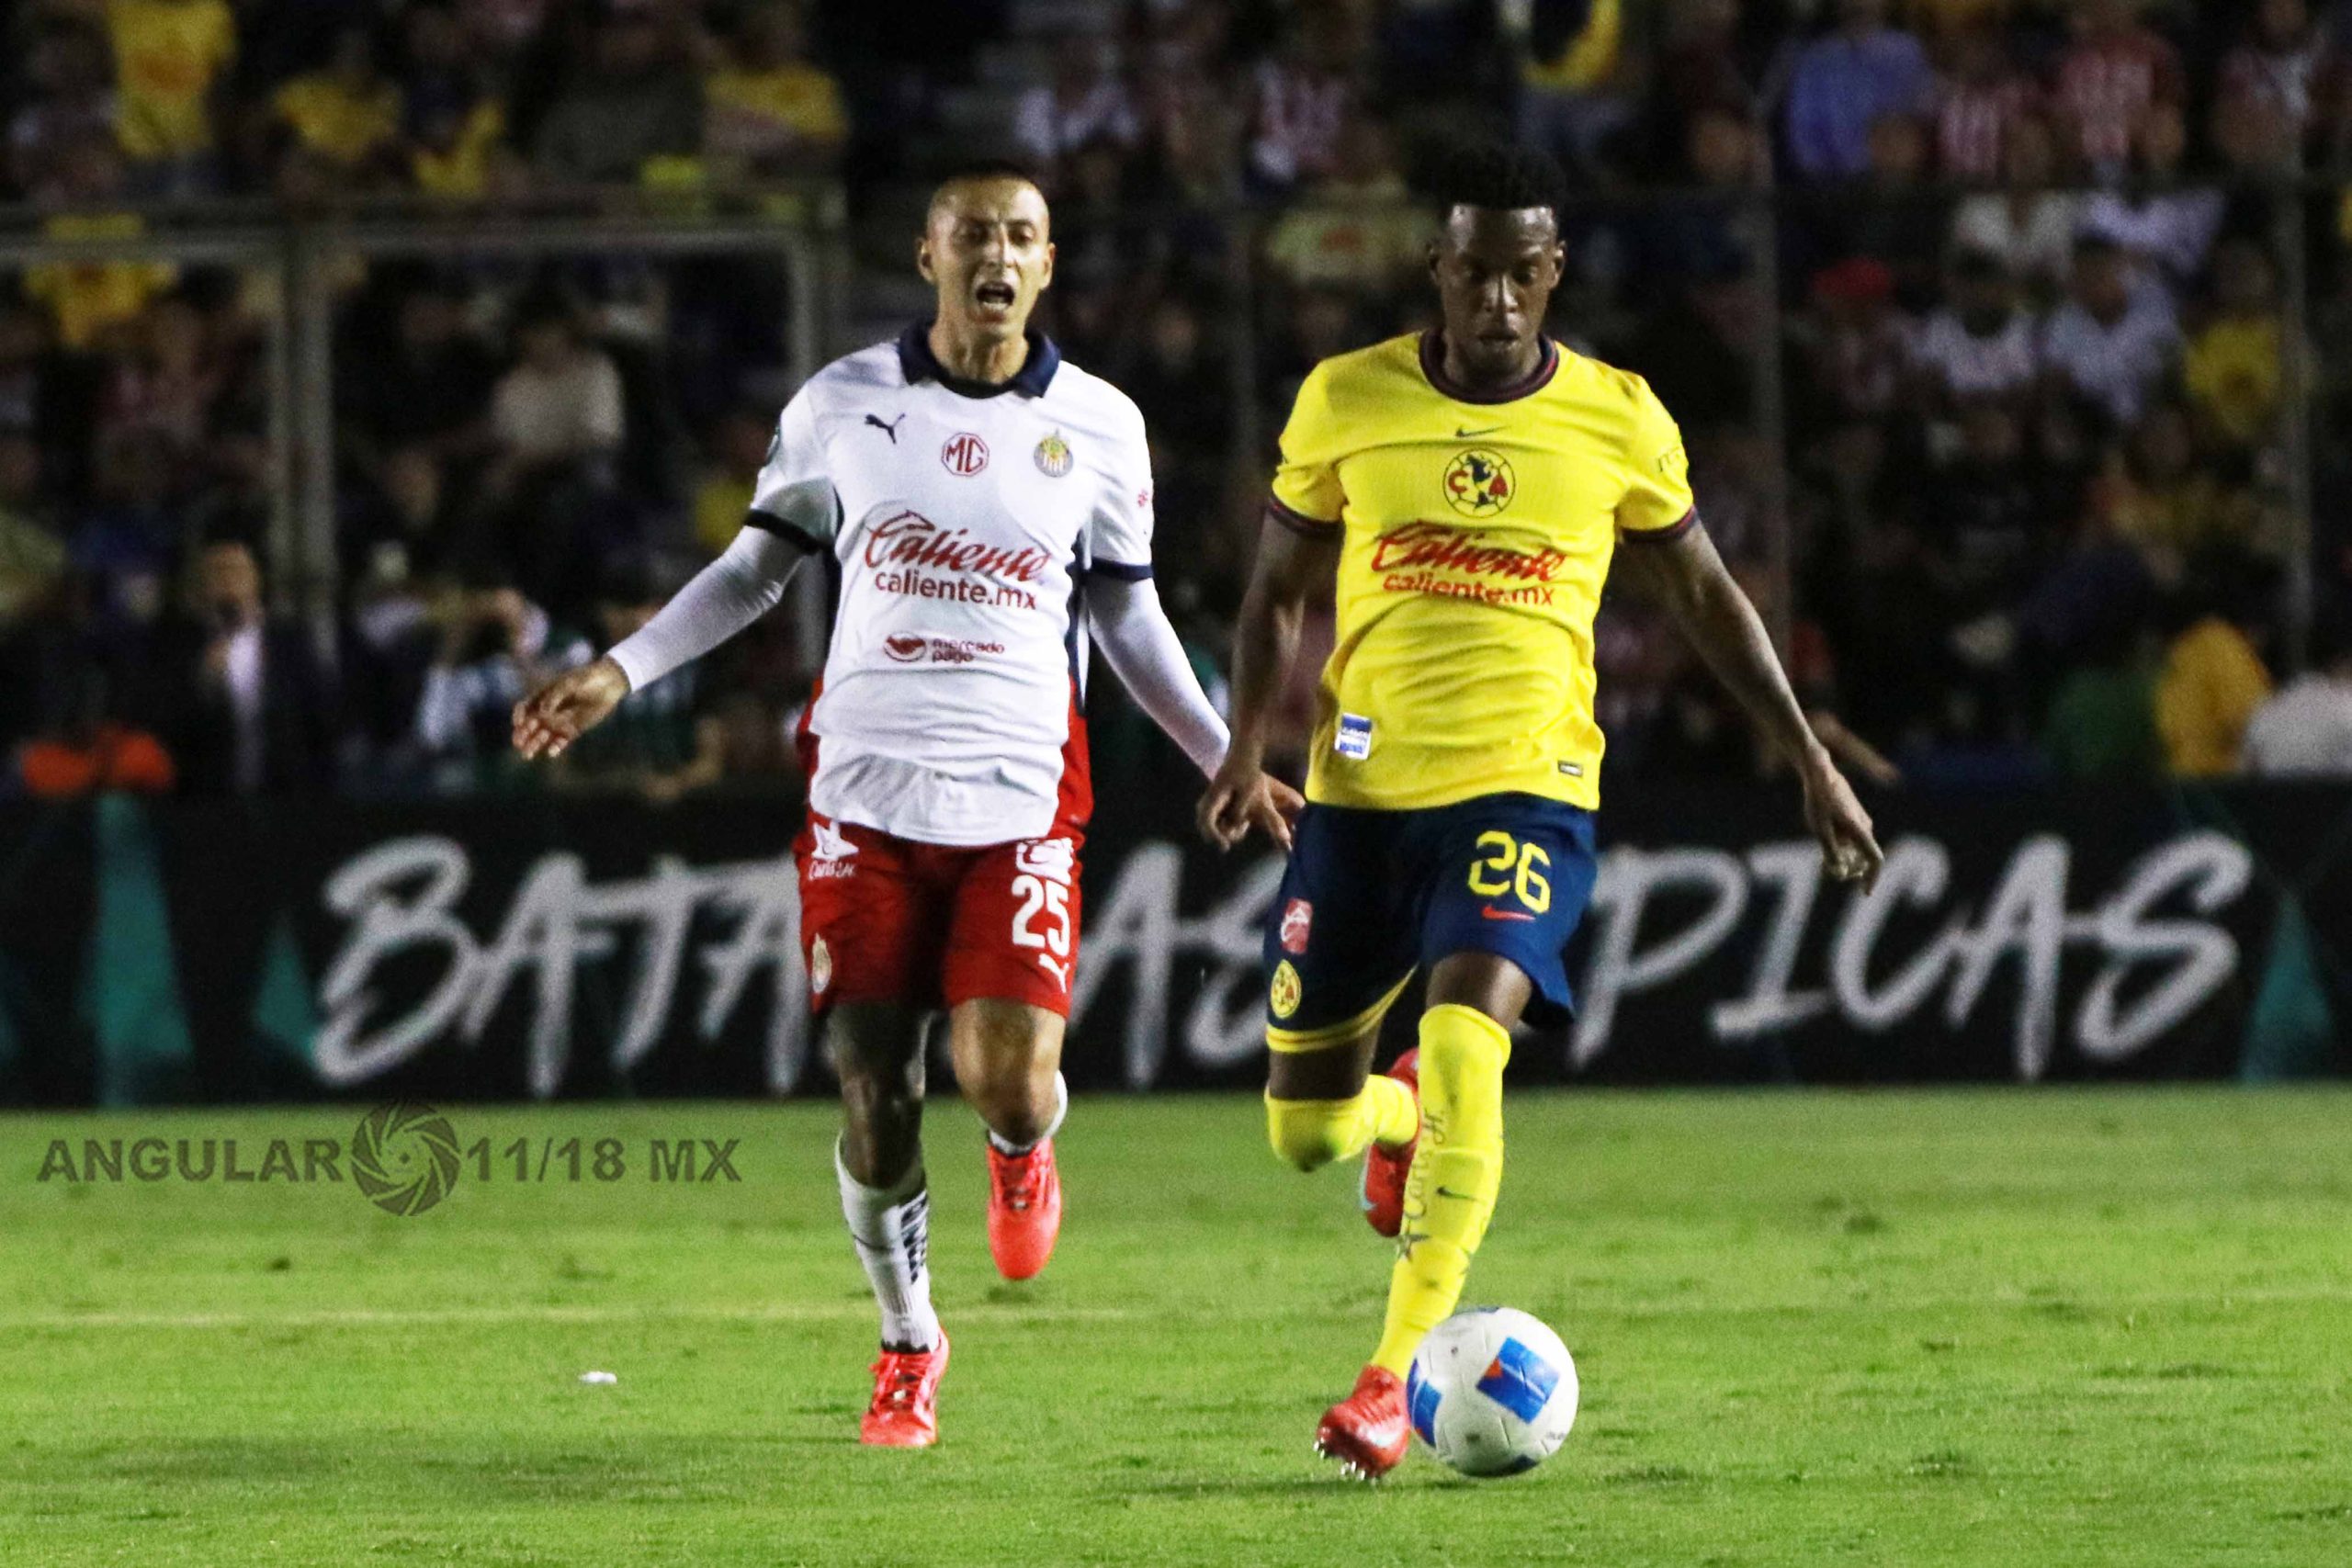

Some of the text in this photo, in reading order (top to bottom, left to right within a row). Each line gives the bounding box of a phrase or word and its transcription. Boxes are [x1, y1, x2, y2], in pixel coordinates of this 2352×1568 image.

[944, 435, 985, 473] MG
[865, 510, 1052, 582] Caliente
[1371, 519, 1567, 581] Caliente
[875, 569, 1036, 610] caliente.mx
[1383, 571, 1555, 605] caliente.mx
[1468, 830, 1551, 913] 26
[1012, 874, 1070, 957] 25
[1562, 831, 2253, 1082] PICAS
